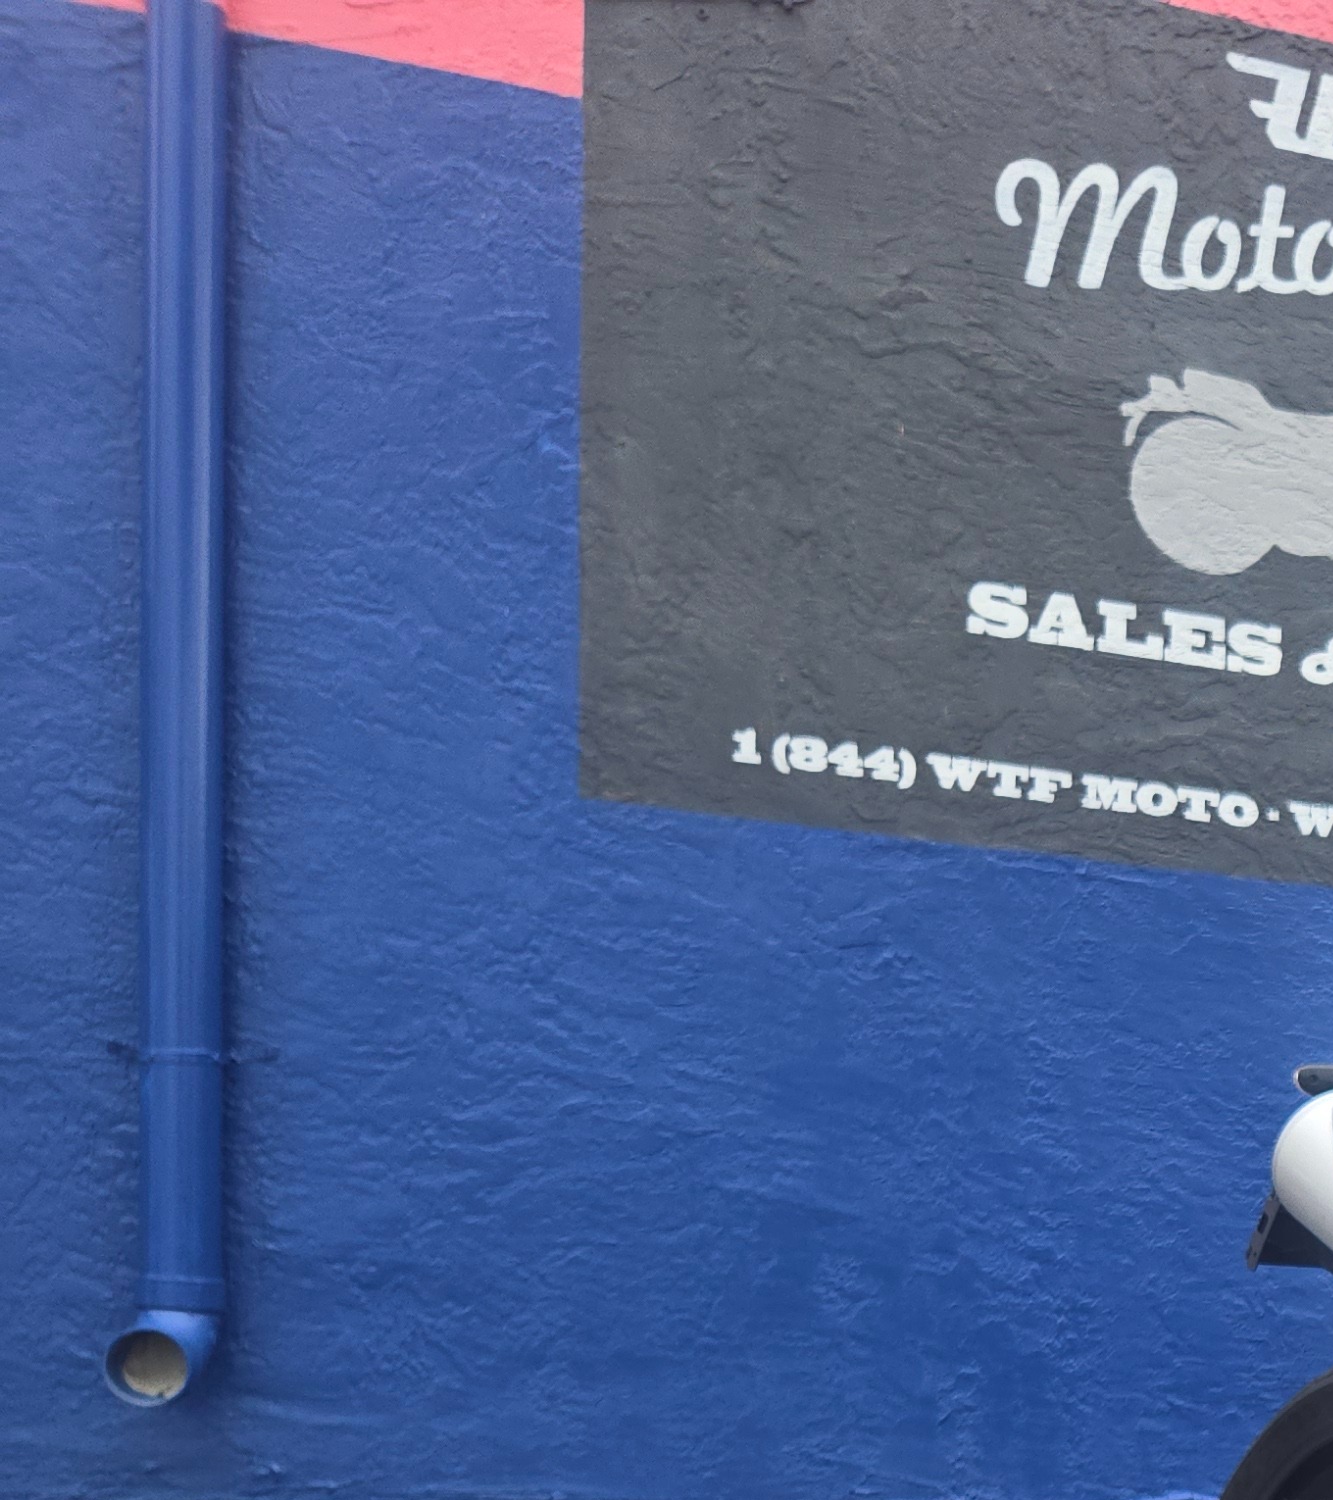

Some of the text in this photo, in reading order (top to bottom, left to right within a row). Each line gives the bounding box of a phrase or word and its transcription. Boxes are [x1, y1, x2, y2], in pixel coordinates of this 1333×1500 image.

[966, 580, 1283, 677] SALES
[731, 727, 761, 765] 1
[771, 733, 916, 789] (844)
[926, 752, 1073, 803] WTF
[1082, 774, 1260, 828] MOTO
